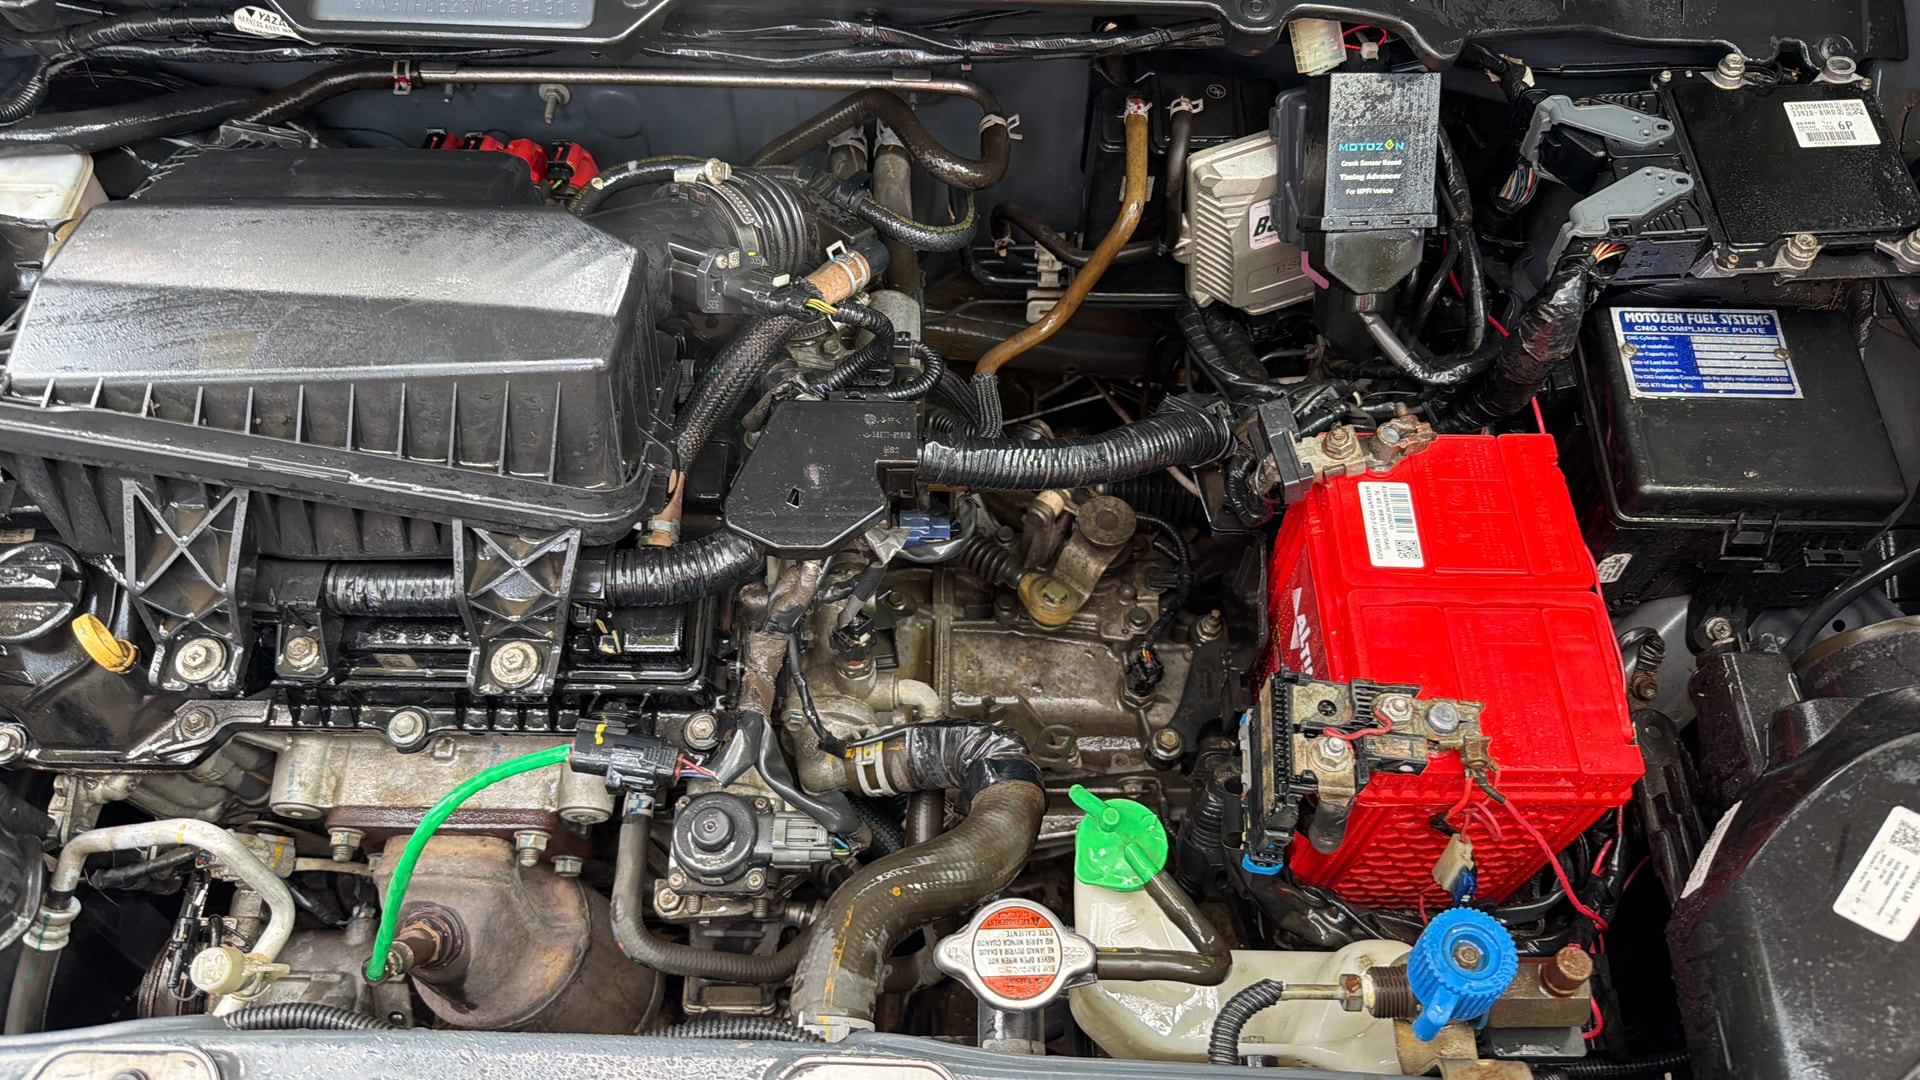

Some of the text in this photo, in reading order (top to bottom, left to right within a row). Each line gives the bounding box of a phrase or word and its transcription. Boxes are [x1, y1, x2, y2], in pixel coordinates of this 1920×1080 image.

[259, 12, 288, 27] YAZA
[1838, 121, 1853, 130] 6P
[1340, 173, 1365, 181] Timing
[1624, 313, 1771, 326] MOTOZEN FUEL SYSTEMS
[1732, 326, 1766, 334] PLATE
